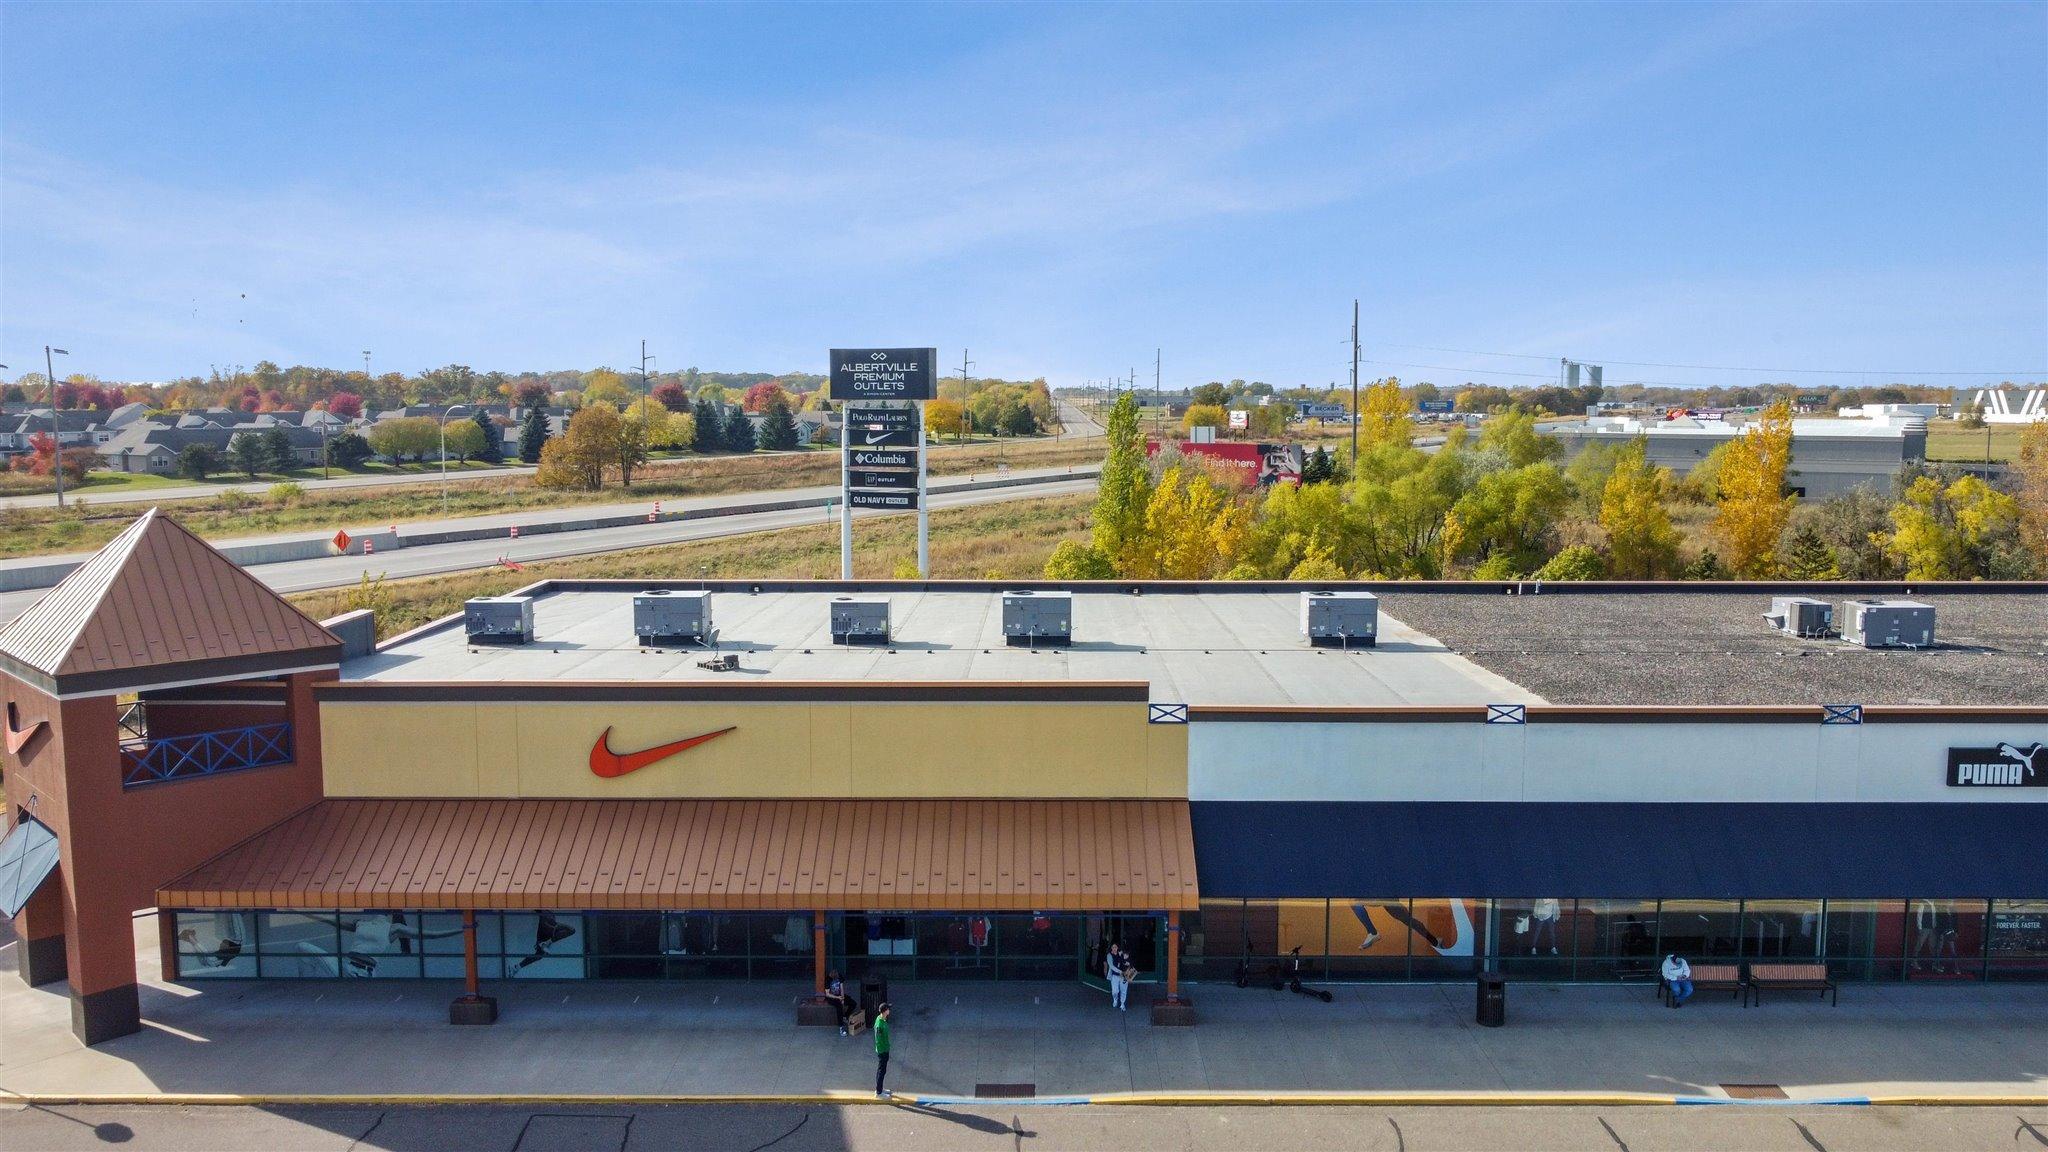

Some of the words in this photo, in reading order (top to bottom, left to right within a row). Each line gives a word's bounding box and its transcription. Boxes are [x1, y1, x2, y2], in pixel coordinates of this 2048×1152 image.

[841, 363, 918, 372] ALBERTVILLE
[854, 373, 905, 381] PREMIUM
[853, 382, 905, 391] OUTLETS
[886, 413, 908, 422] LAUREN
[865, 453, 906, 464] Columbia
[1235, 458, 1258, 468] here.
[1958, 764, 2023, 784] PUMA
